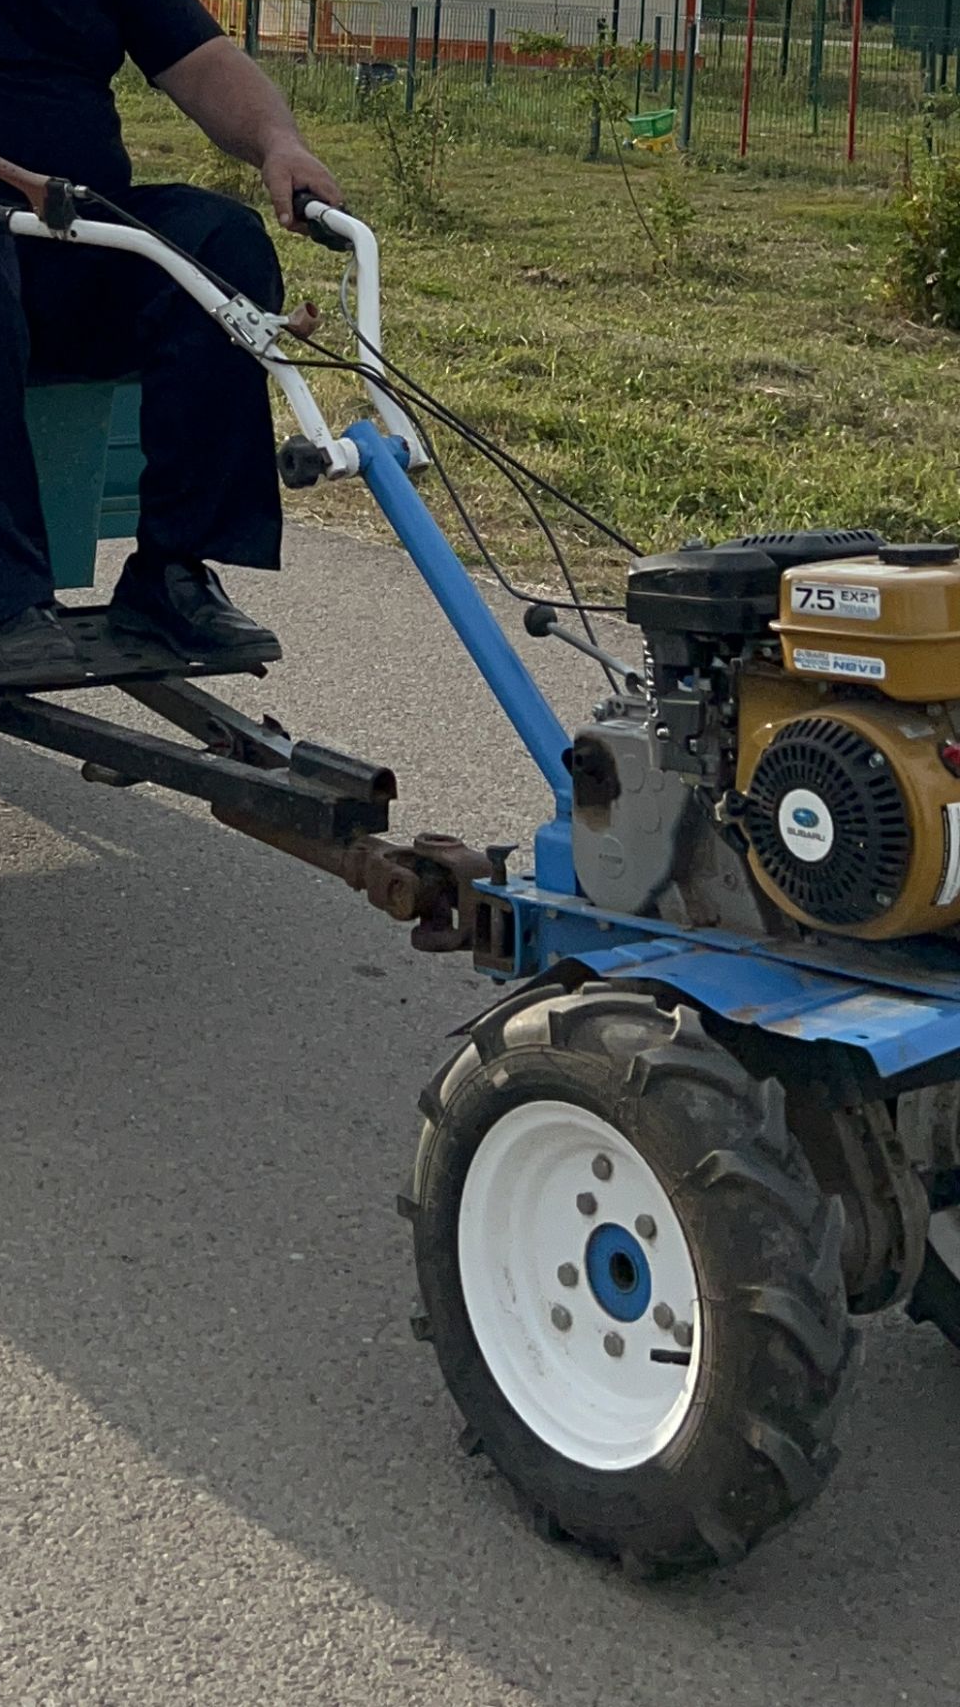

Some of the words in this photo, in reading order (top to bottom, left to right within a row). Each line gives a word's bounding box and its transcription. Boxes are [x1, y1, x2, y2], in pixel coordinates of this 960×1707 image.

[795, 587, 835, 611] 7.5
[841, 590, 877, 604] EX21
[786, 826, 826, 843] SUBARU
